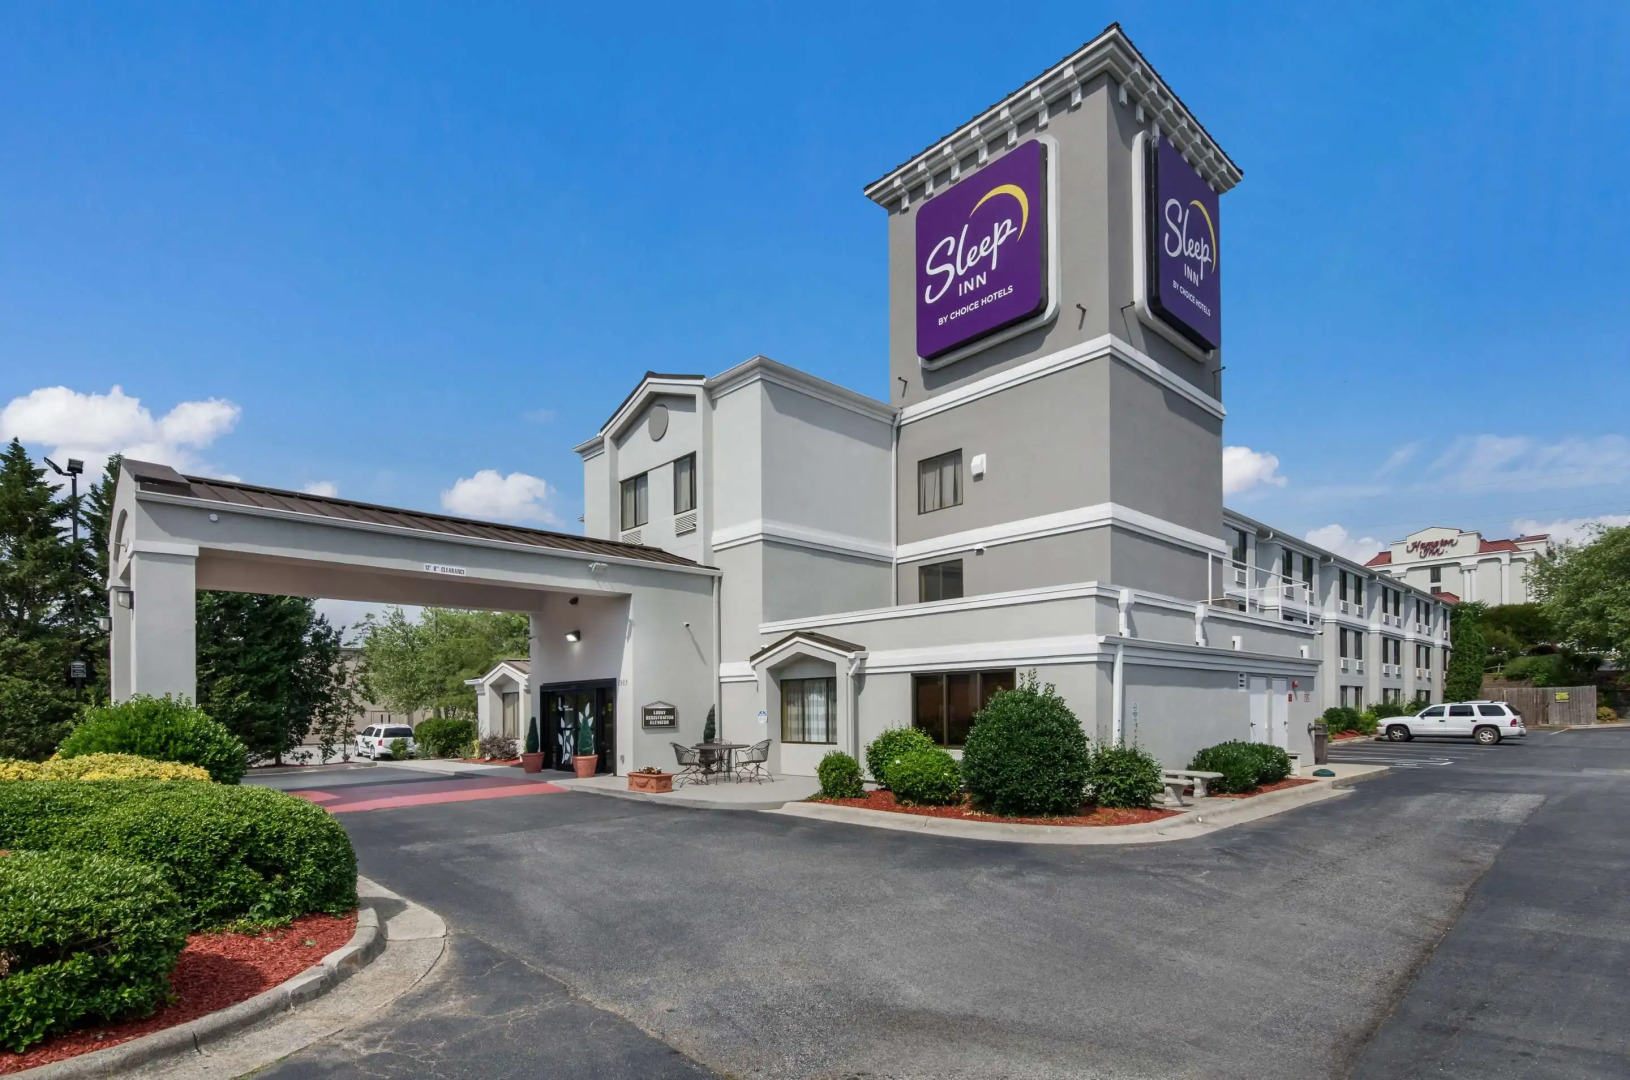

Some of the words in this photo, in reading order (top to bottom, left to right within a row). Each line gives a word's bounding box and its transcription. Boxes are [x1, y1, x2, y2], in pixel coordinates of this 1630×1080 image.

[1164, 198, 1212, 281] Sleep
[925, 219, 1017, 304] Sleep
[1184, 263, 1199, 287] INN
[958, 271, 987, 297] INN
[1172, 280, 1179, 289] BY
[1179, 285, 1195, 304] CHOICE
[1195, 298, 1211, 317] HOTELS
[938, 314, 949, 326] BY
[950, 301, 980, 320] CHOICE
[981, 285, 1014, 307] HOTELS
[1406, 538, 1458, 554] Hampton
[1419, 547, 1445, 558] Inn
